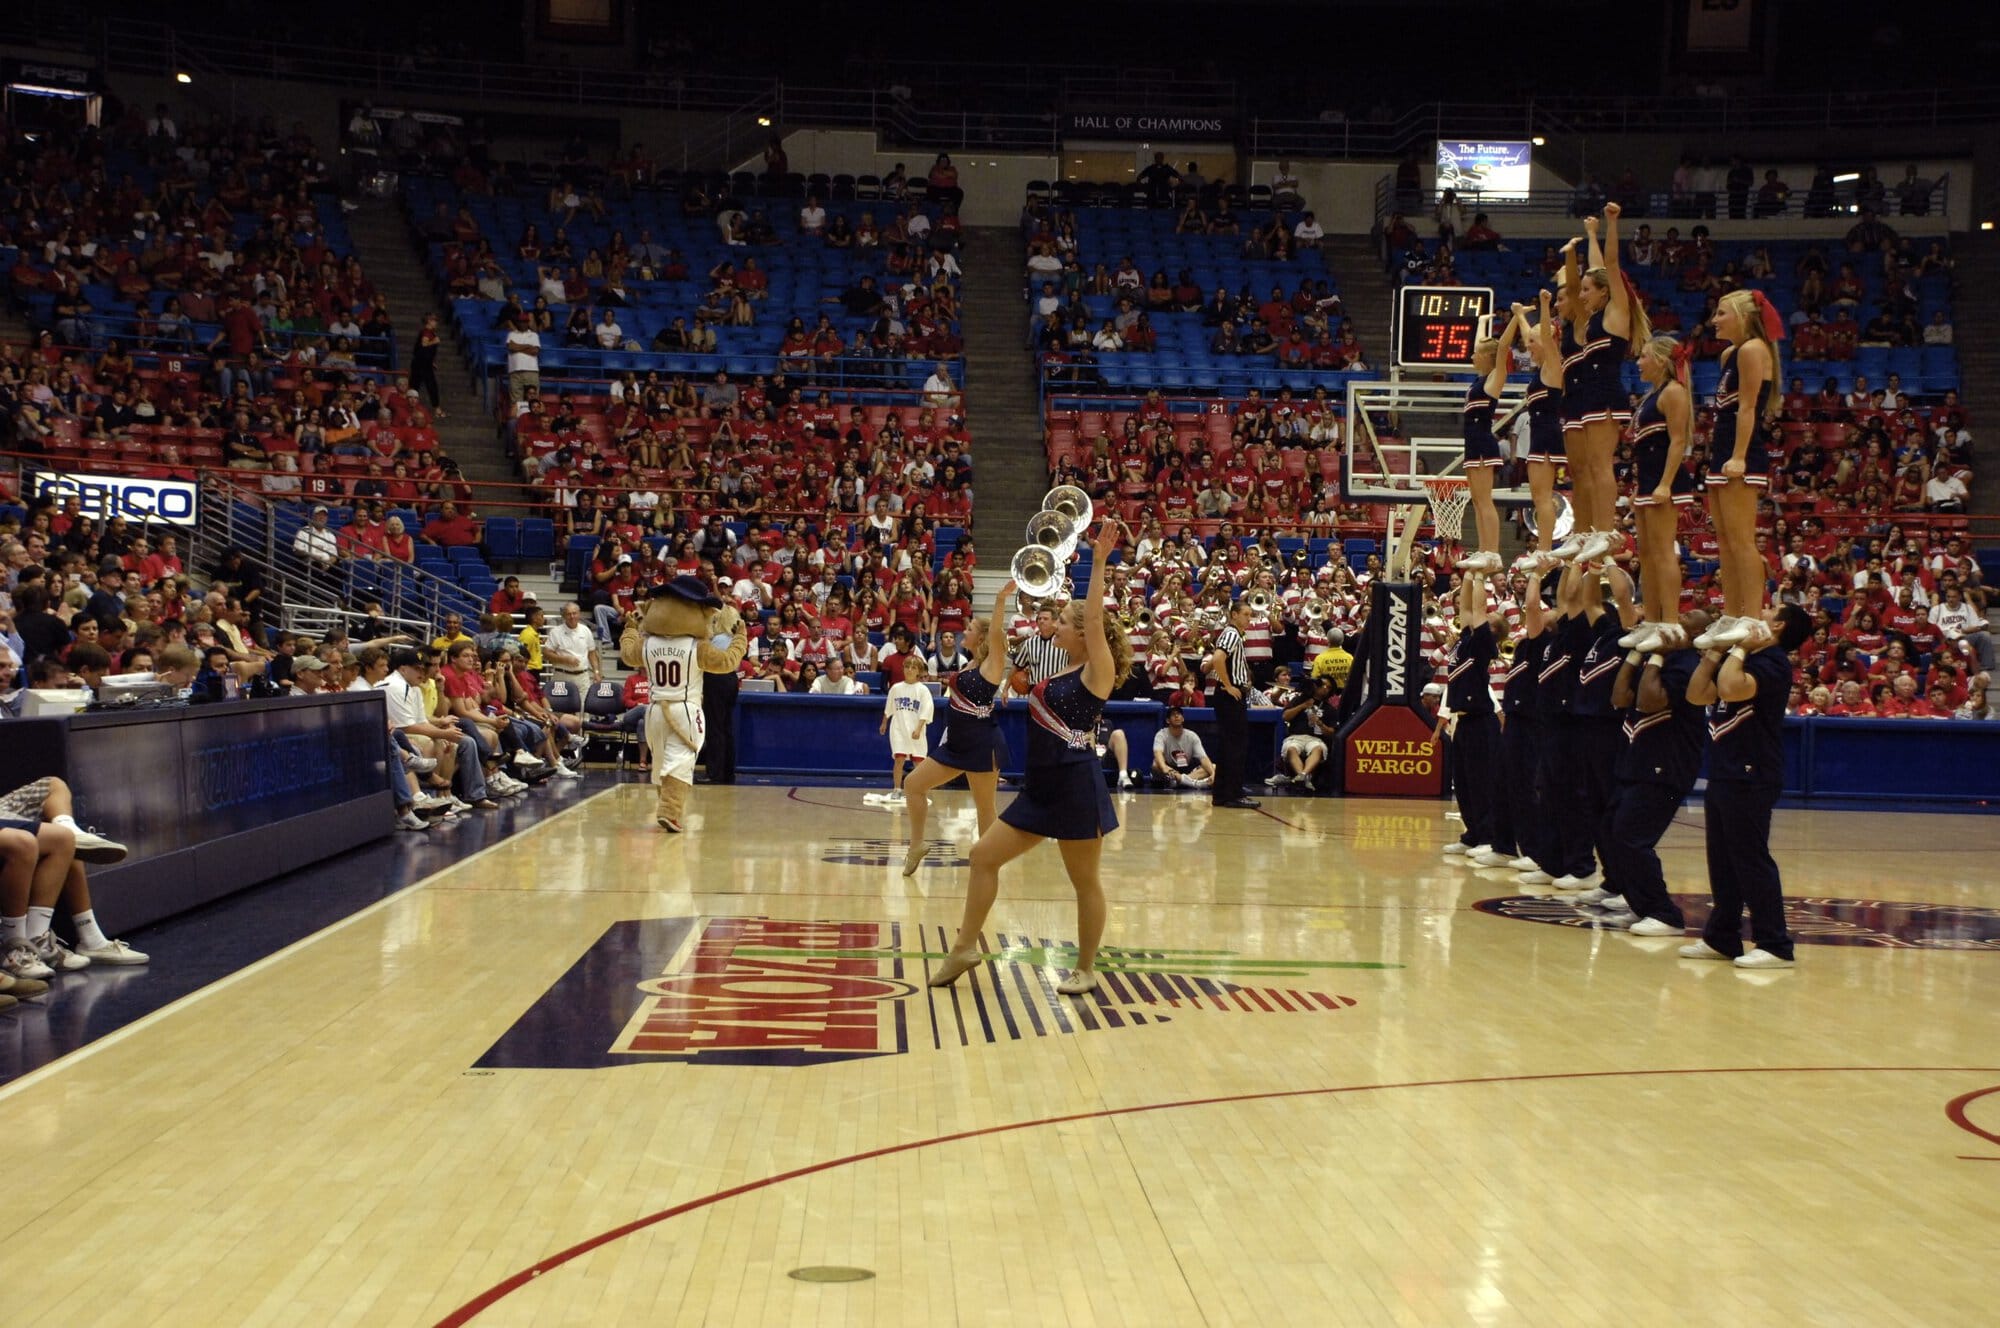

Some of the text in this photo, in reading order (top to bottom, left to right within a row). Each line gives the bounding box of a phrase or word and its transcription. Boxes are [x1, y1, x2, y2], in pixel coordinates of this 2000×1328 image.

[20, 64, 89, 84] PEPSI
[1074, 116, 1222, 131] HALL OF CHAMPIONS
[1459, 144, 1475, 153] The
[1419, 295, 1482, 317] 10:14
[1421, 325, 1470, 359] 35
[168, 361, 182, 372] 19
[1211, 404, 1224, 414] 21
[311, 479, 325, 492] 19
[650, 646, 686, 659] WILBUR
[1386, 592, 1408, 697] ARIZONA
[655, 660, 681, 688] 00
[1355, 740, 1434, 756] WELLS
[1357, 758, 1432, 775] FARGO
